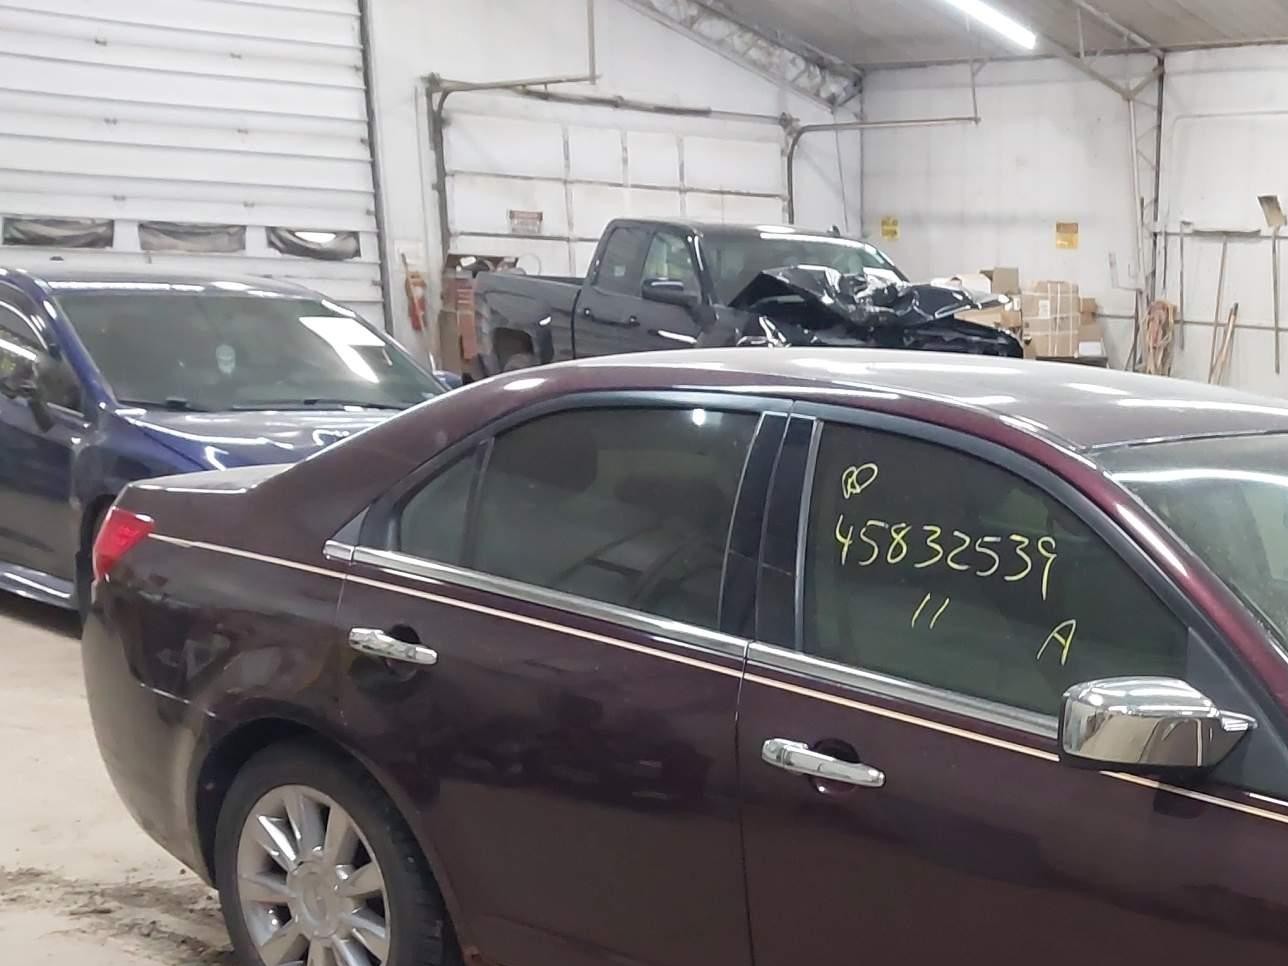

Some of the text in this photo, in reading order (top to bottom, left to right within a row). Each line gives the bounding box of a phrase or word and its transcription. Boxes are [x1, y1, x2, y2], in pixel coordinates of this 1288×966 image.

[834, 514, 1057, 600] 45832539
[911, 592, 949, 629] 11
[1036, 619, 1076, 666] A
